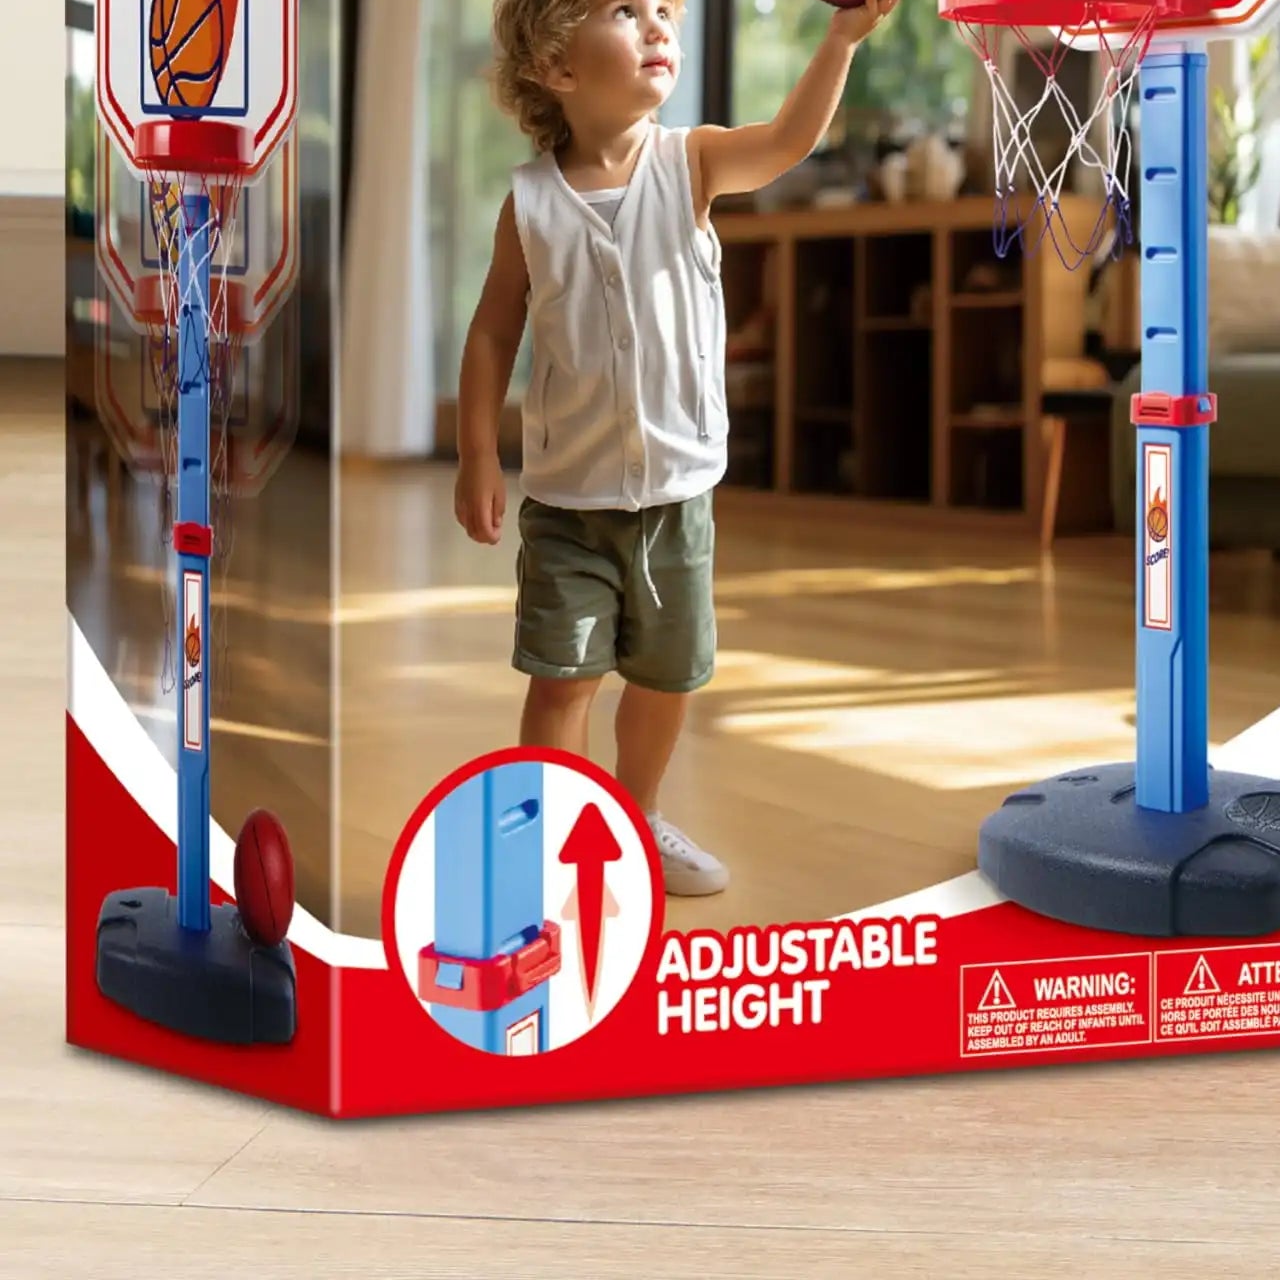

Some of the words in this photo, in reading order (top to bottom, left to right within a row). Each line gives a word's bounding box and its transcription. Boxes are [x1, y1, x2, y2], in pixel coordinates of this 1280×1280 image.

[656, 921, 937, 983] ADJUSTABLE
[1033, 971, 1136, 1001] WARNING:
[658, 981, 831, 1035] HEIGHT
[1160, 998, 1174, 1010] CE
[1175, 995, 1215, 1009] PRODUIT
[1217, 991, 1266, 1006] NÉCESSITE
[1268, 991, 1280, 1002] UN
[967, 1012, 989, 1025] THIS
[990, 1009, 1035, 1023] PRODUCT
[1036, 1005, 1083, 1020] REQUIRES
[1085, 1002, 1135, 1015] ASSEMBLY.
[1161, 1010, 1186, 1023] HORS
[1188, 1009, 1201, 1021] DE
[1203, 1005, 1239, 1019] PORTÉE
[1240, 1005, 1259, 1017] DES
[967, 1025, 993, 1037] KEEP
[994, 1024, 1013, 1036] OUT
[1015, 1023, 1029, 1034] OF
[1030, 1020, 1063, 1033] REACH
[1064, 1019, 1077, 1030] OF
[1078, 1016, 1117, 1029] INFANTS
[1118, 1014, 1145, 1026] UNTIL
[1160, 1024, 1173, 1035] CE
[1200, 1020, 1221, 1032] SOIT
[1222, 1016, 1271, 1030] ASSEMBLÉ
[967, 1035, 1024, 1051] ASSEMBLED
[1026, 1034, 1038, 1046] BY
[1040, 1033, 1053, 1045] AN
[1055, 1031, 1086, 1043] ADULT.
